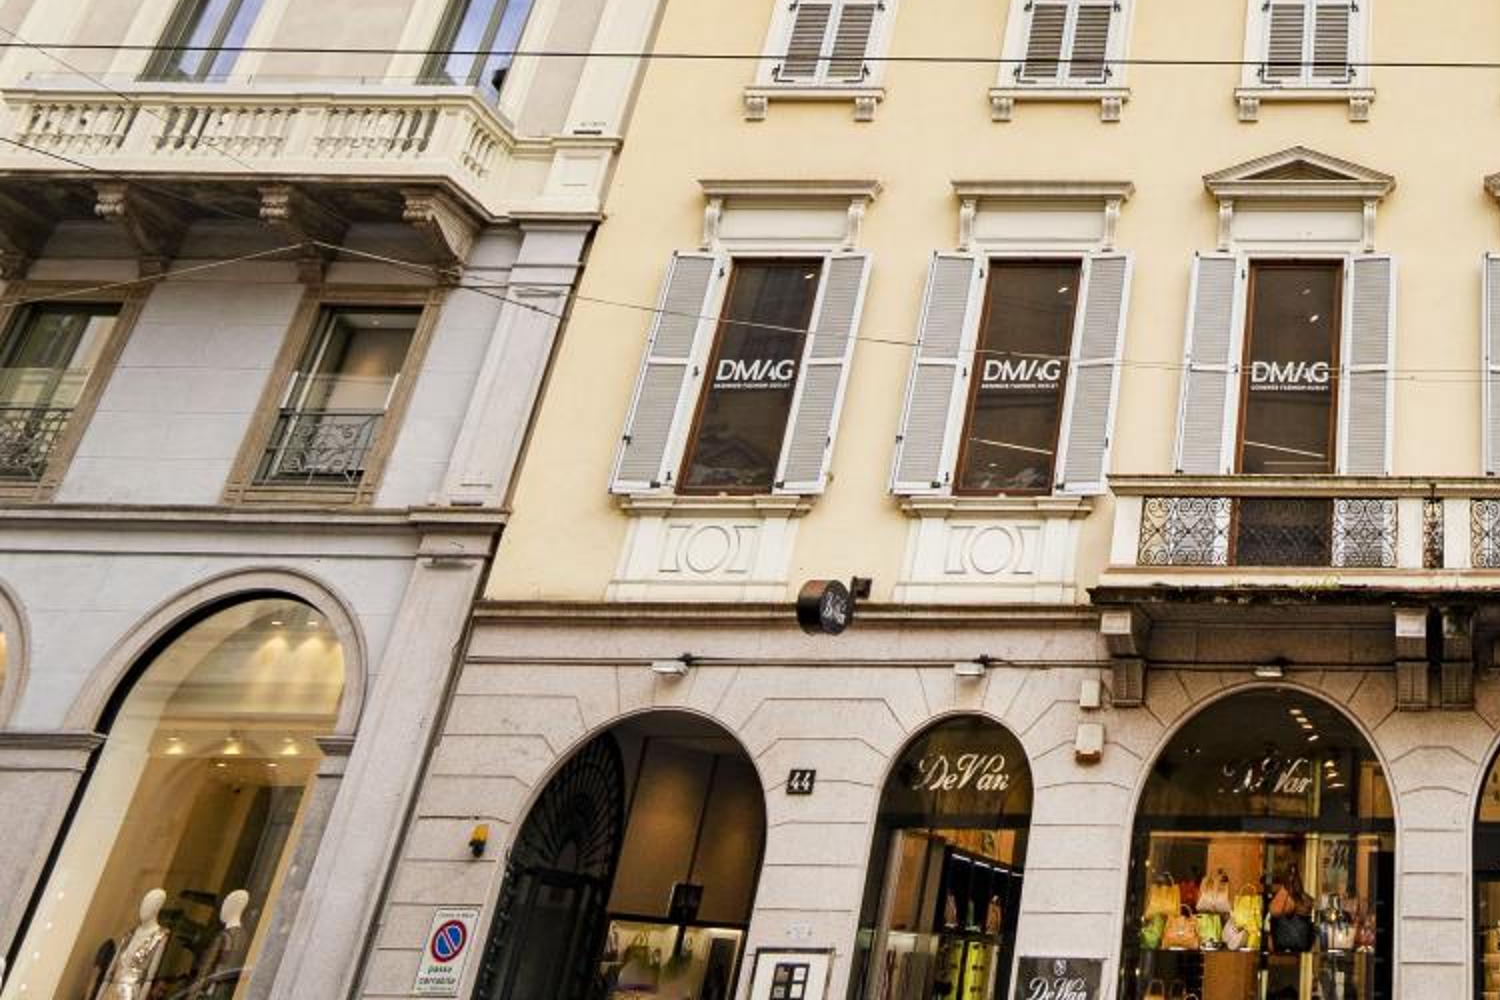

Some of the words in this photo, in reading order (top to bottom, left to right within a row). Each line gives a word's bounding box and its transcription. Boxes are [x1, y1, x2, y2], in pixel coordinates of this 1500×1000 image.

[715, 359, 795, 381] DMAG
[983, 359, 1061, 381] DMAG
[1251, 361, 1329, 383] DMAG
[790, 771, 811, 790] 44
